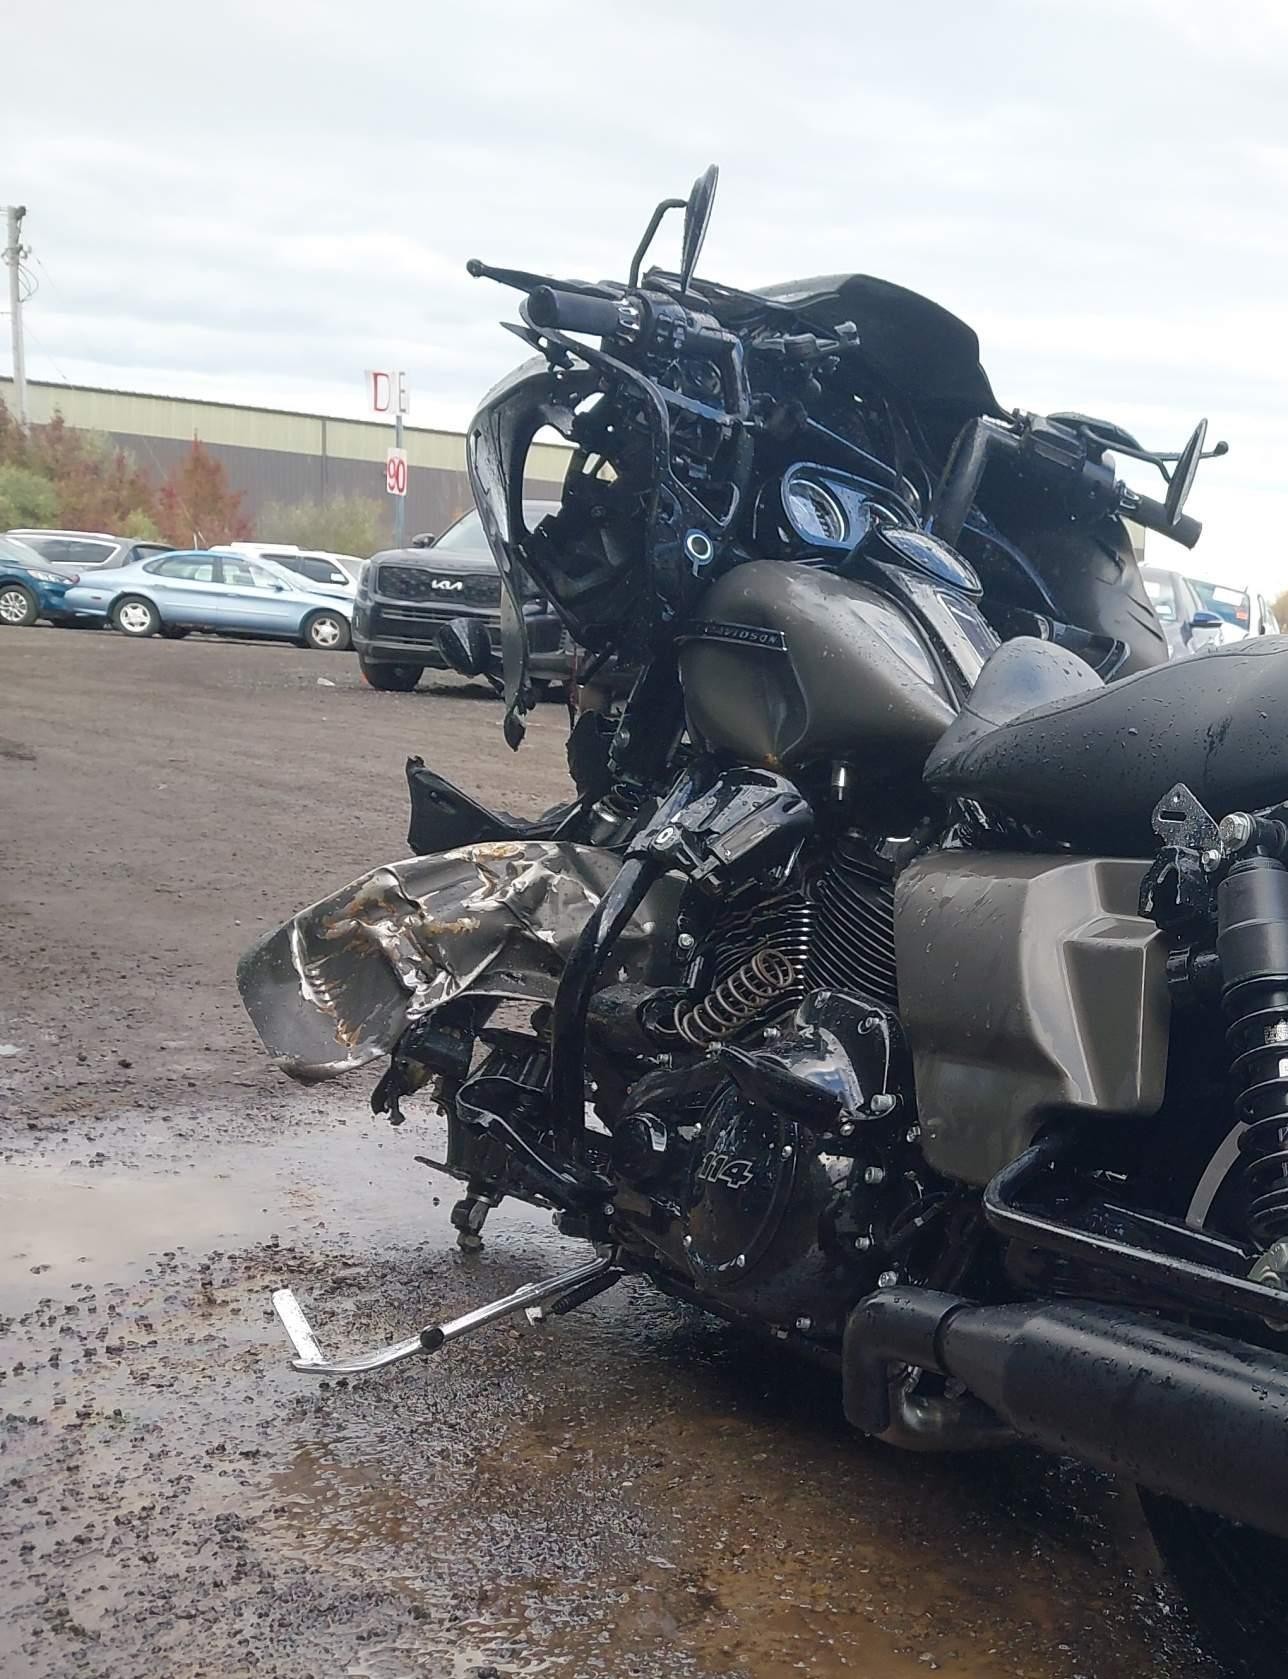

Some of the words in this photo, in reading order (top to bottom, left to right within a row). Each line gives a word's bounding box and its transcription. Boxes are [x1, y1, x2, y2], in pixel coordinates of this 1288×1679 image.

[388, 457, 406, 493] 90
[707, 624, 779, 645] AVIDSON
[698, 1151, 753, 1189] 114
